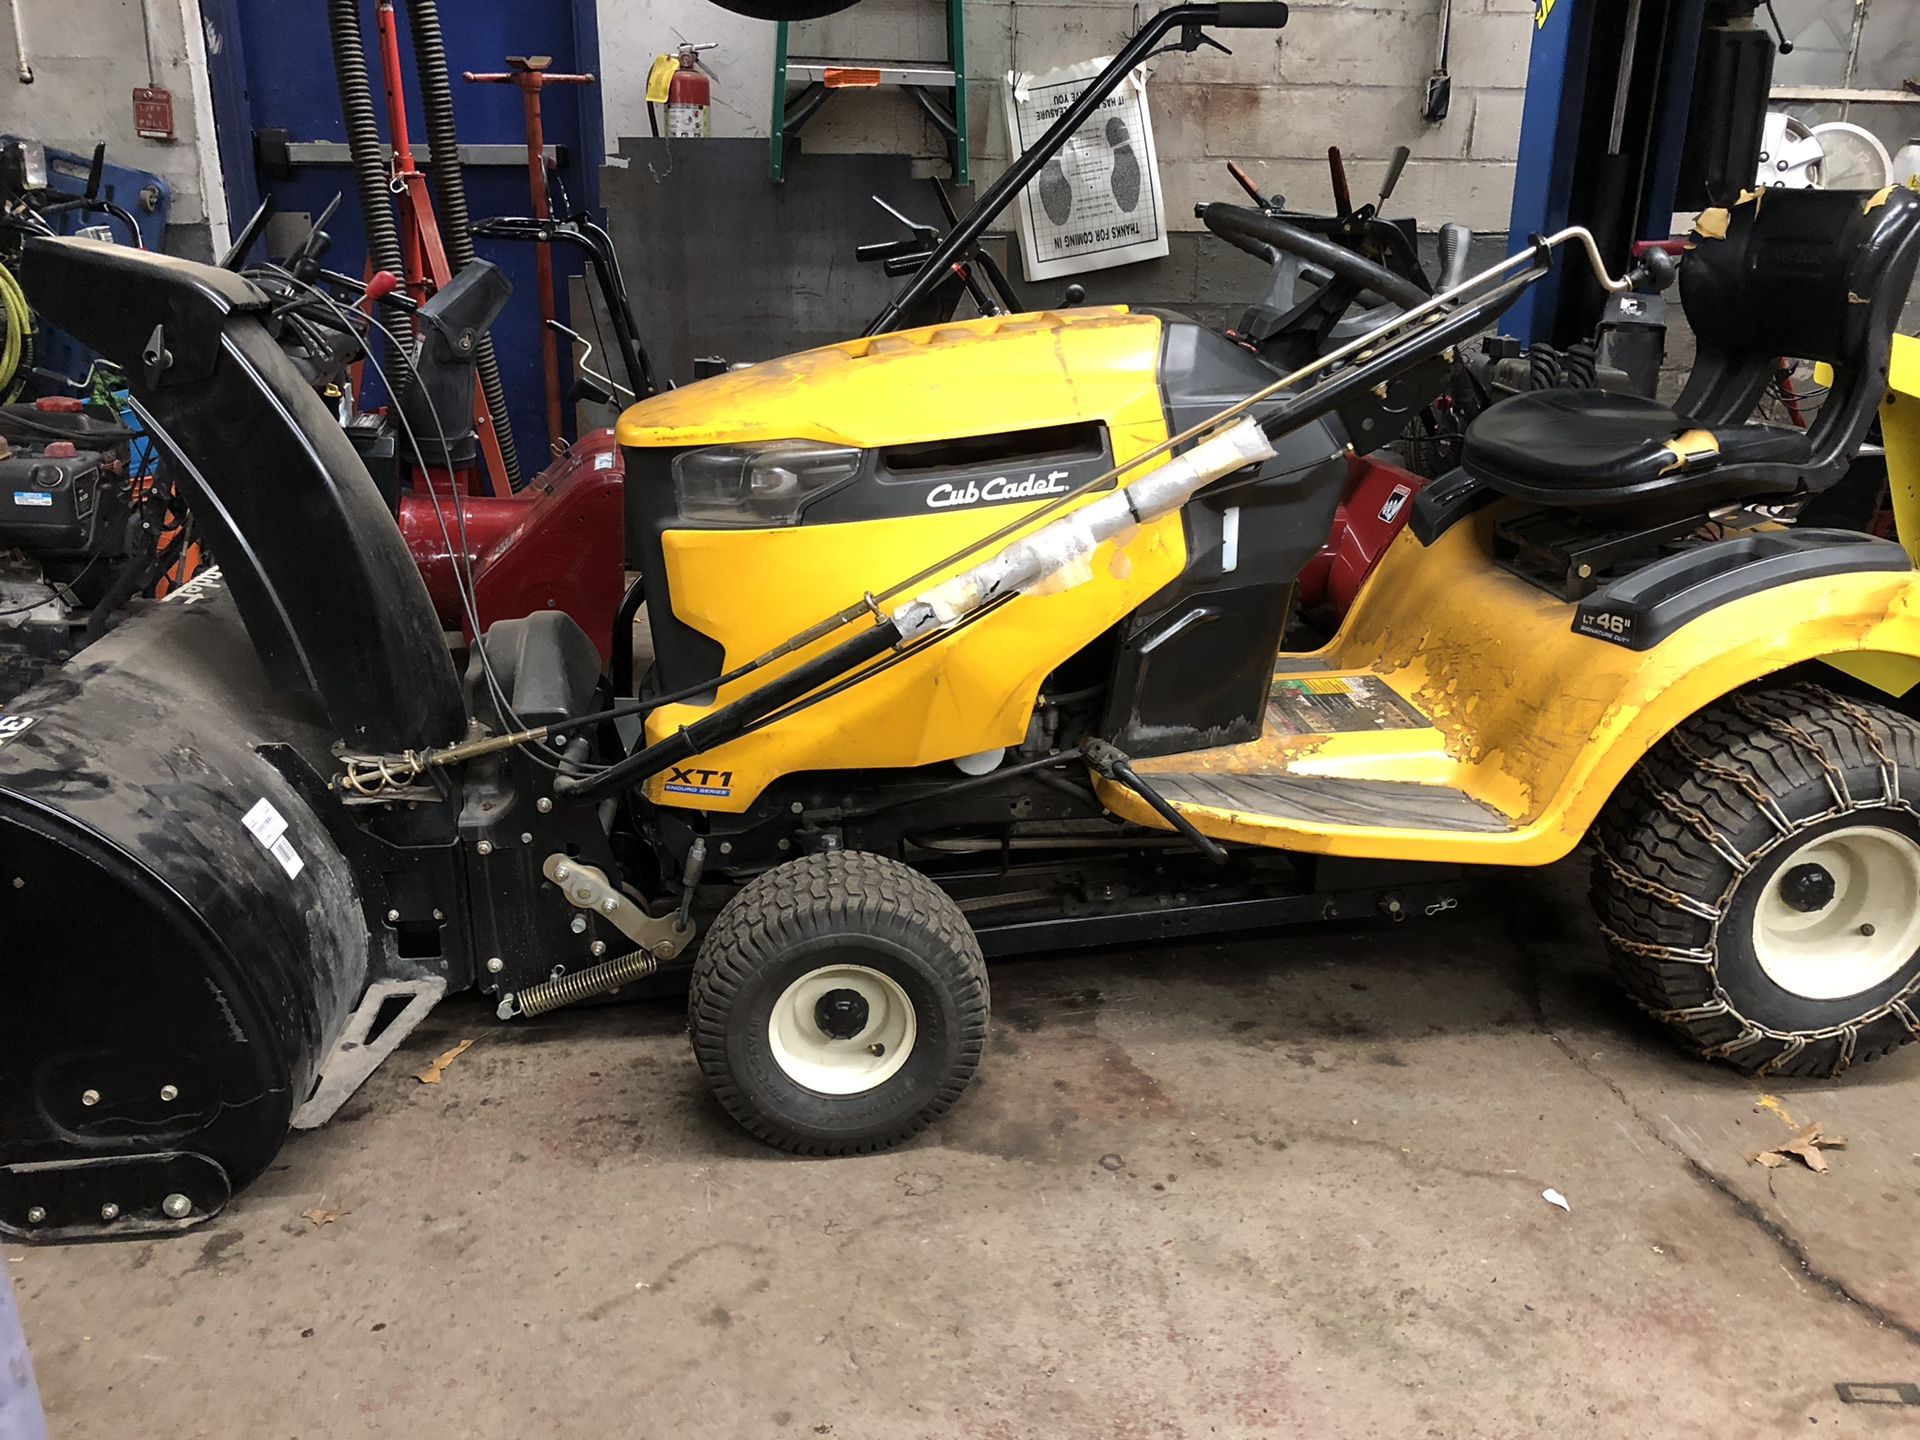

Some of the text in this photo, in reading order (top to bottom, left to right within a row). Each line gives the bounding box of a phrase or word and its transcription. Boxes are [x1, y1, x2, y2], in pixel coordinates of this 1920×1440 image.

[1036, 95, 1125, 120] IT HAS LEASURE
[1053, 94, 1069, 105] YOU
[1053, 222, 1140, 249] THANKS FOR COMING IN
[926, 470, 1069, 508] Cub Cadet
[161, 564, 223, 604] adet
[1580, 625, 1613, 639] SIGNATURE
[1582, 612, 1631, 634] LT 46"
[666, 766, 733, 787] XT1
[665, 785, 698, 793] ENDURO
